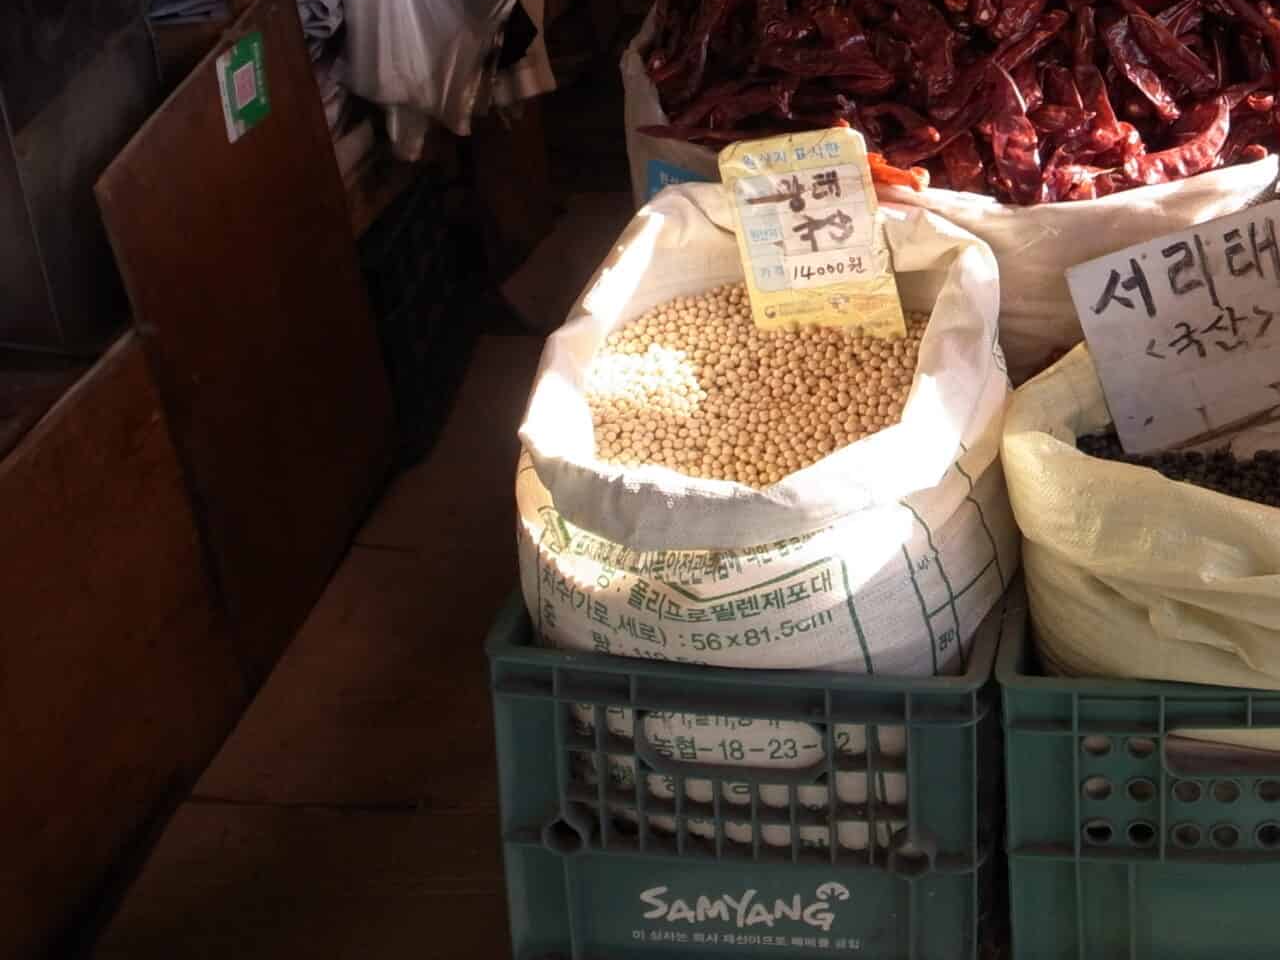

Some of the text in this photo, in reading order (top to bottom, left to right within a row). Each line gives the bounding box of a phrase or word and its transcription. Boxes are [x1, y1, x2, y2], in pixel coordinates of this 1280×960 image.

[792, 255, 868, 281] 14000원
[628, 569, 833, 624] 폴리프로필렌제포대
[640, 884, 846, 931] SAMYANG
